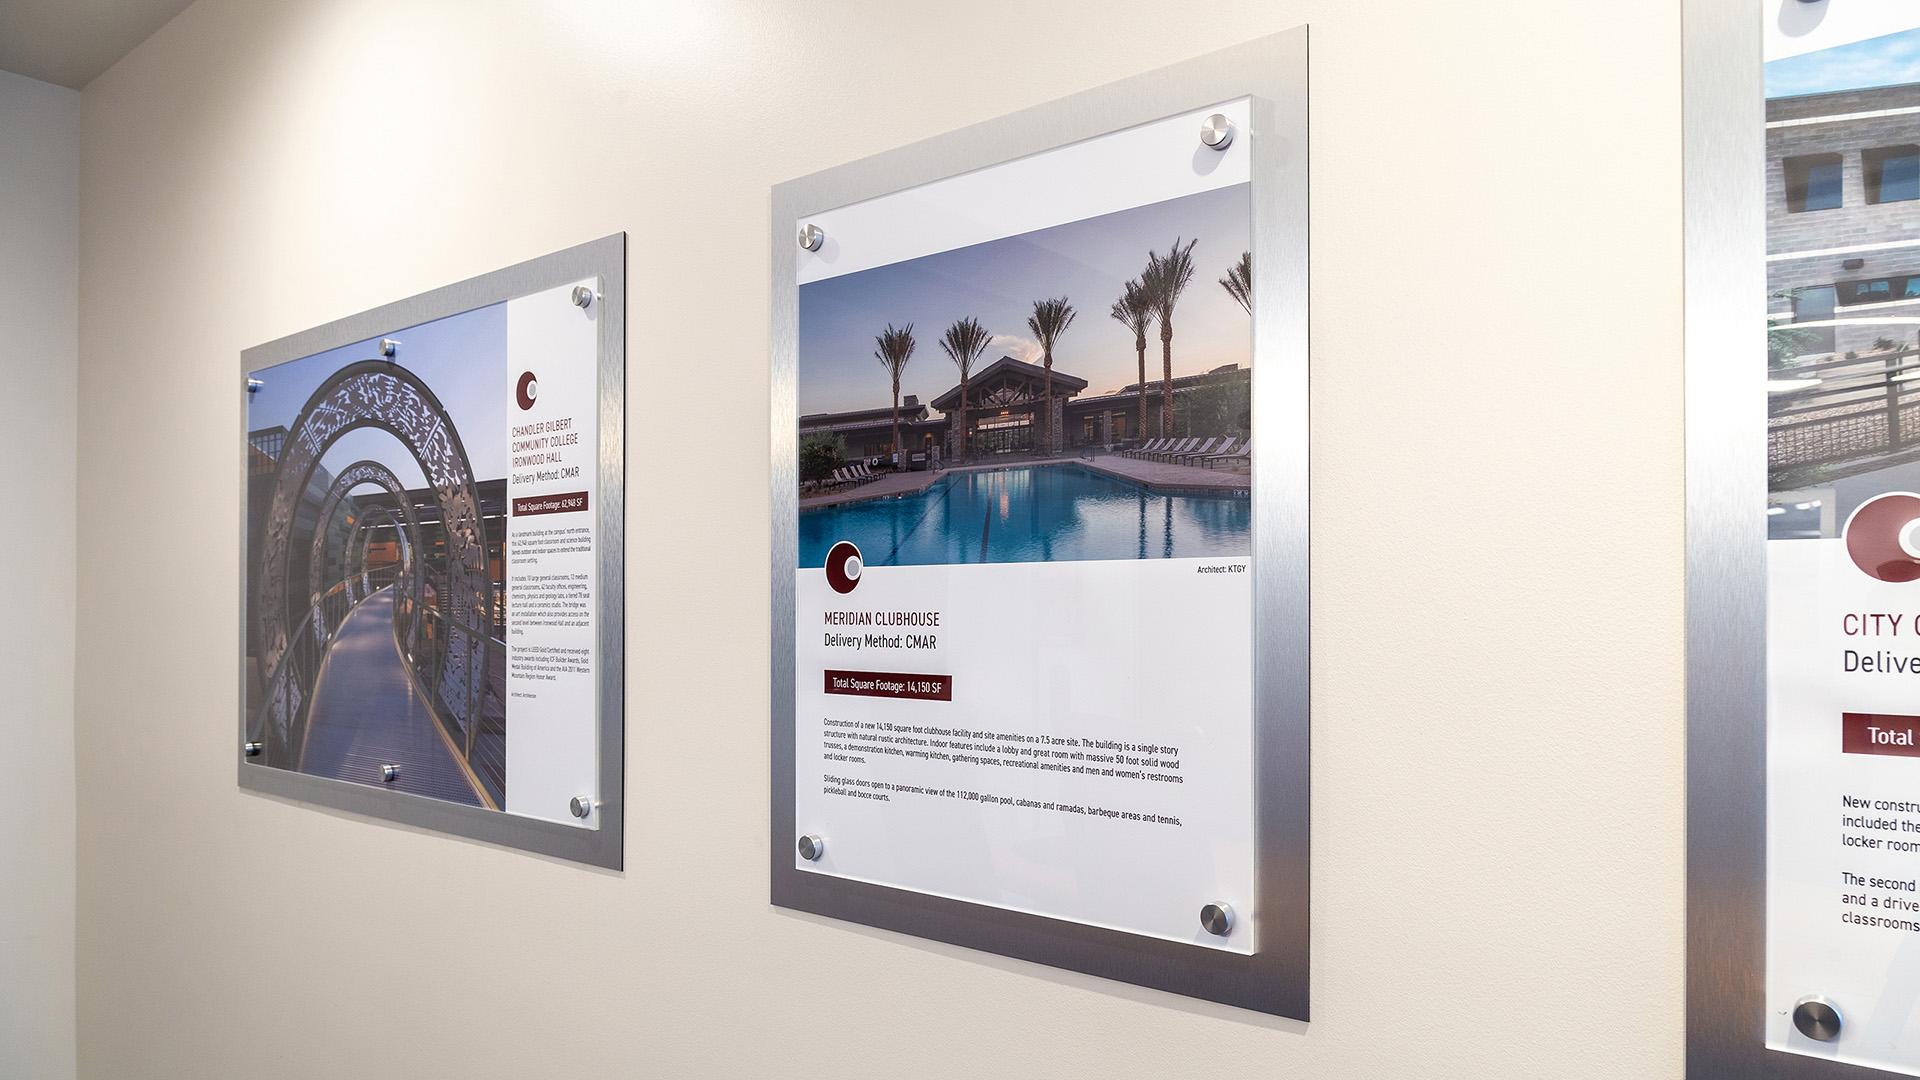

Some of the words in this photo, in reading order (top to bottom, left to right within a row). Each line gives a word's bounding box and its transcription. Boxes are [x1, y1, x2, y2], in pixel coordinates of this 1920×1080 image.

[512, 423, 544, 438] CHANDLER
[546, 418, 572, 433] GILBERT
[512, 438, 549, 453] COMMUNITY
[550, 433, 578, 448] COLLEGE
[513, 454, 545, 468] IRONWOOD
[546, 452, 562, 463] HALL
[513, 474, 535, 485] Delivery
[537, 469, 559, 482] Method:
[561, 466, 580, 479] CMAR
[518, 504, 527, 512] Total
[528, 503, 542, 512] Square
[543, 501, 561, 511] Footage:
[576, 498, 583, 507] SF
[1197, 566, 1227, 574] Architect:
[1228, 565, 1246, 573] KTGY
[825, 612, 872, 626] MERIDIAN
[875, 612, 940, 627] CLUBHOUSE
[1843, 613, 1903, 636] CITY
[825, 633, 862, 651] Delivery
[865, 634, 903, 648] Method:
[906, 635, 936, 649] CMAR
[833, 677, 849, 690] Total
[850, 678, 874, 691] Square
[876, 680, 905, 694] Footage:
[908, 681, 930, 694] 14,150
[932, 682, 942, 694] SF
[824, 718, 854, 728] Construction
[877, 722, 893, 731] 14,150
[894, 726, 912, 734] square
[913, 725, 923, 734] foot
[924, 727, 951, 736] clubhouse
[952, 729, 972, 740] facility
[972, 731, 983, 739] and
[984, 731, 995, 740] site
[996, 733, 1025, 743] amenities
[1041, 735, 1050, 744] 7.5
[1051, 738, 1065, 746] acre
[1067, 738, 1080, 747] site.
[1082, 738, 1094, 748] The
[1096, 740, 1123, 752] building
[1124, 742, 1130, 751] is
[1132, 744, 1136, 752] a
[1138, 743, 1159, 755] single
[1160, 746, 1179, 757] story
[1867, 727, 1914, 746] Total
[824, 731, 846, 739] structure
[847, 732, 858, 740] with
[859, 734, 877, 742] natural
[878, 735, 894, 743] rustic
[895, 737, 929, 746] architecture.
[930, 739, 948, 748] Indoor
[949, 741, 973, 751] features
[974, 743, 996, 753] include
[1002, 745, 1019, 756] lobby
[1020, 748, 1032, 756] and
[1033, 750, 1050, 758] great
[1052, 751, 1069, 759] room
[1070, 751, 1084, 760] with
[1086, 754, 1114, 764] massive
[1116, 755, 1124, 764] 50
[1126, 756, 1139, 766] foot
[1141, 758, 1158, 767] solid
[1160, 760, 1179, 769] wood
[834, 753, 848, 762] locker
[849, 756, 866, 764] rooms.
[824, 742, 843, 751] trusses,
[848, 744, 883, 754] demonstration
[884, 747, 904, 757] kitchen,
[905, 750, 929, 761] warming
[930, 751, 951, 762] kitchen,
[952, 754, 979, 766] gathering
[980, 758, 1002, 767] spaces,
[1003, 760, 1039, 770] recreational
[1040, 763, 1071, 773] amenities
[1072, 766, 1084, 774] and
[1101, 768, 1114, 777] and
[1115, 770, 1146, 780] women's
[1147, 774, 1183, 784] restrooms
[824, 786, 846, 796] pickleball
[848, 790, 857, 798] and
[858, 790, 872, 800] bocce
[872, 794, 890, 802] courts.
[824, 774, 841, 786] Sliding
[842, 777, 855, 786] glass
[856, 779, 870, 788] doors
[871, 782, 884, 790] open
[896, 785, 924, 794] panoramic
[925, 787, 938, 796] view
[939, 789, 945, 797] of
[946, 790, 955, 798] the
[957, 791, 979, 801] 112,000
[980, 794, 998, 804] gallon
[1000, 797, 1015, 806] pool,
[1016, 798, 1042, 809] cabanas
[1043, 802, 1055, 811] and
[1056, 804, 1086, 815] ramadas,
[1088, 806, 1120, 819] barbeque
[1121, 812, 1141, 821] areas
[1142, 814, 1156, 823] and
[1158, 816, 1182, 827] tennis,
[1842, 795, 1871, 808] New
[1842, 815, 1897, 831] included
[1842, 834, 1883, 849] locker
[1842, 872, 1865, 886] The
[1869, 878, 1916, 892] second
[1842, 894, 1866, 906] and
[1871, 898, 1878, 907] a
[1884, 897, 1919, 912] drive
